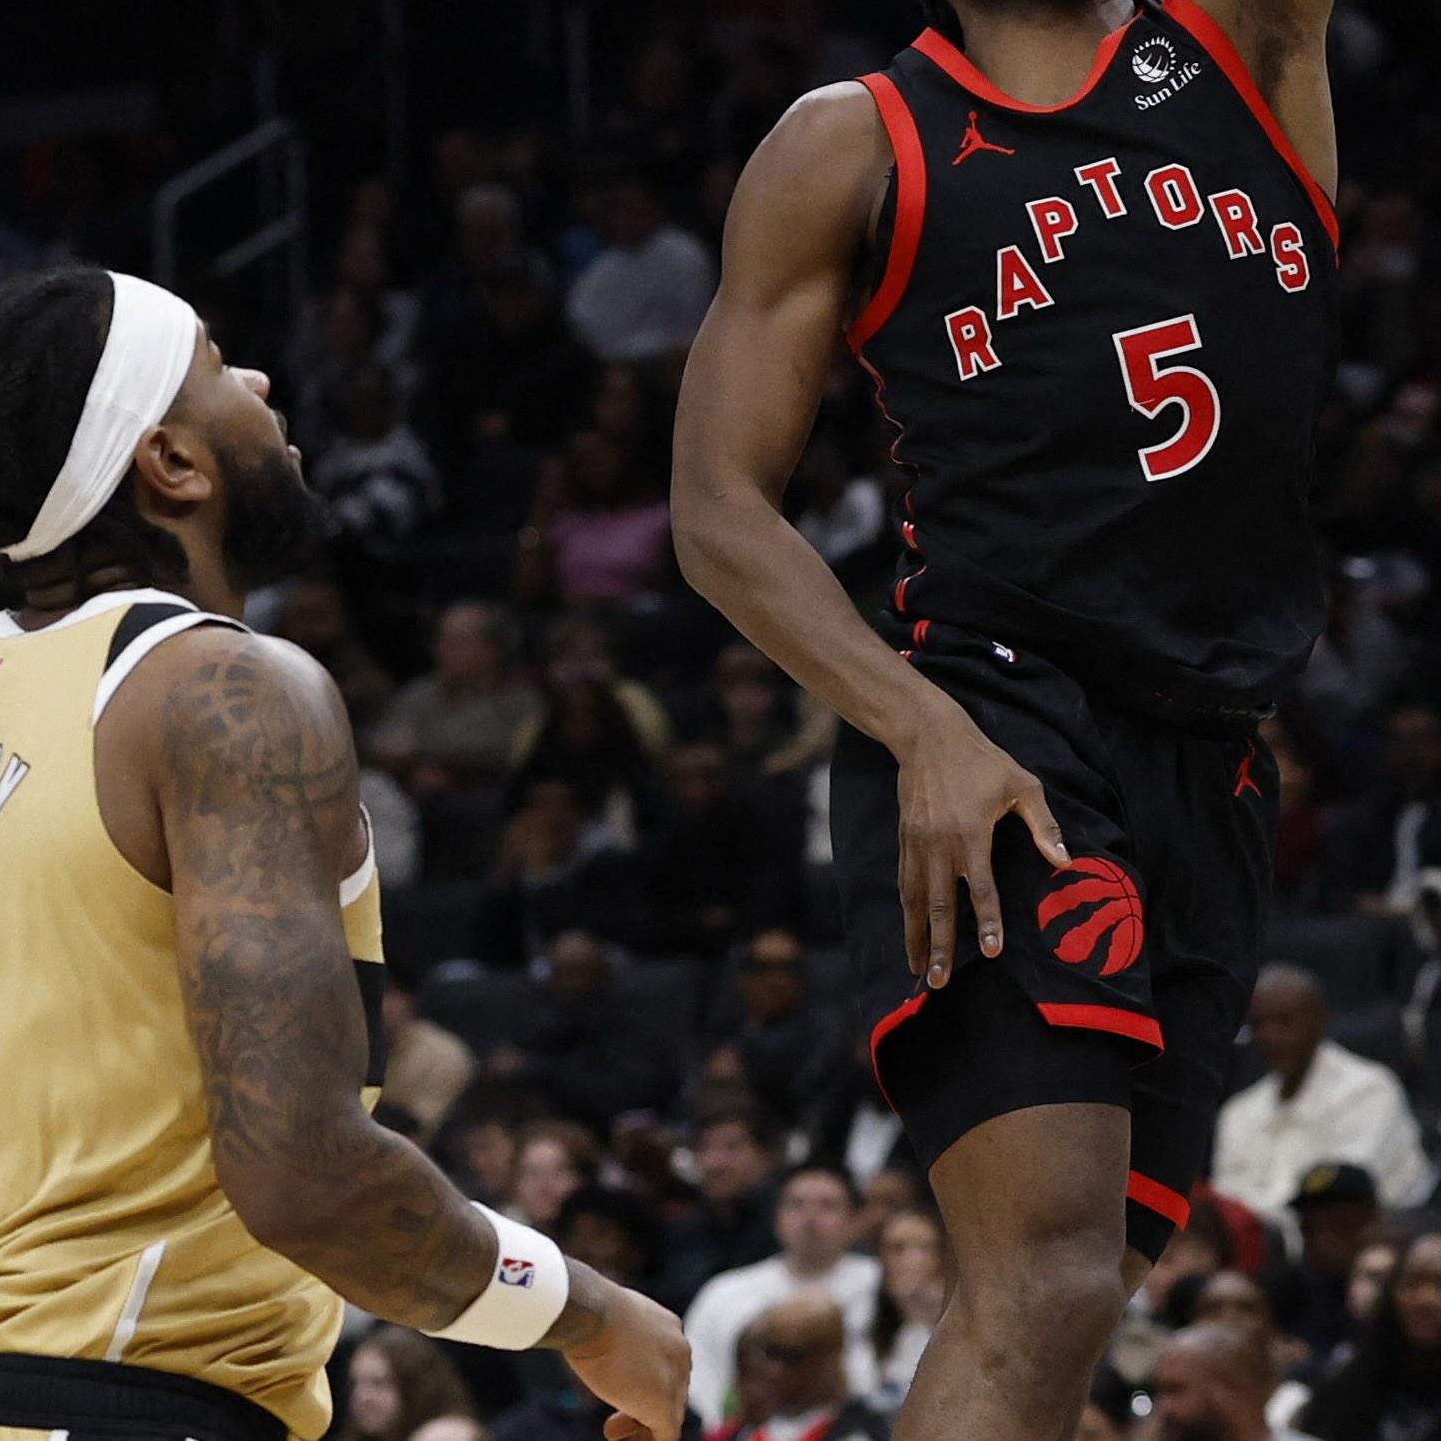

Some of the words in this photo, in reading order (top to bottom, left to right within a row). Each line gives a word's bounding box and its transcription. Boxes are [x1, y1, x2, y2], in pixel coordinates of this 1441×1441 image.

[1134, 87, 1172, 110] Sun
[1169, 62, 1202, 91] Life
[944, 156, 1310, 381] RAPTORS
[1112, 313, 1222, 482] 5
